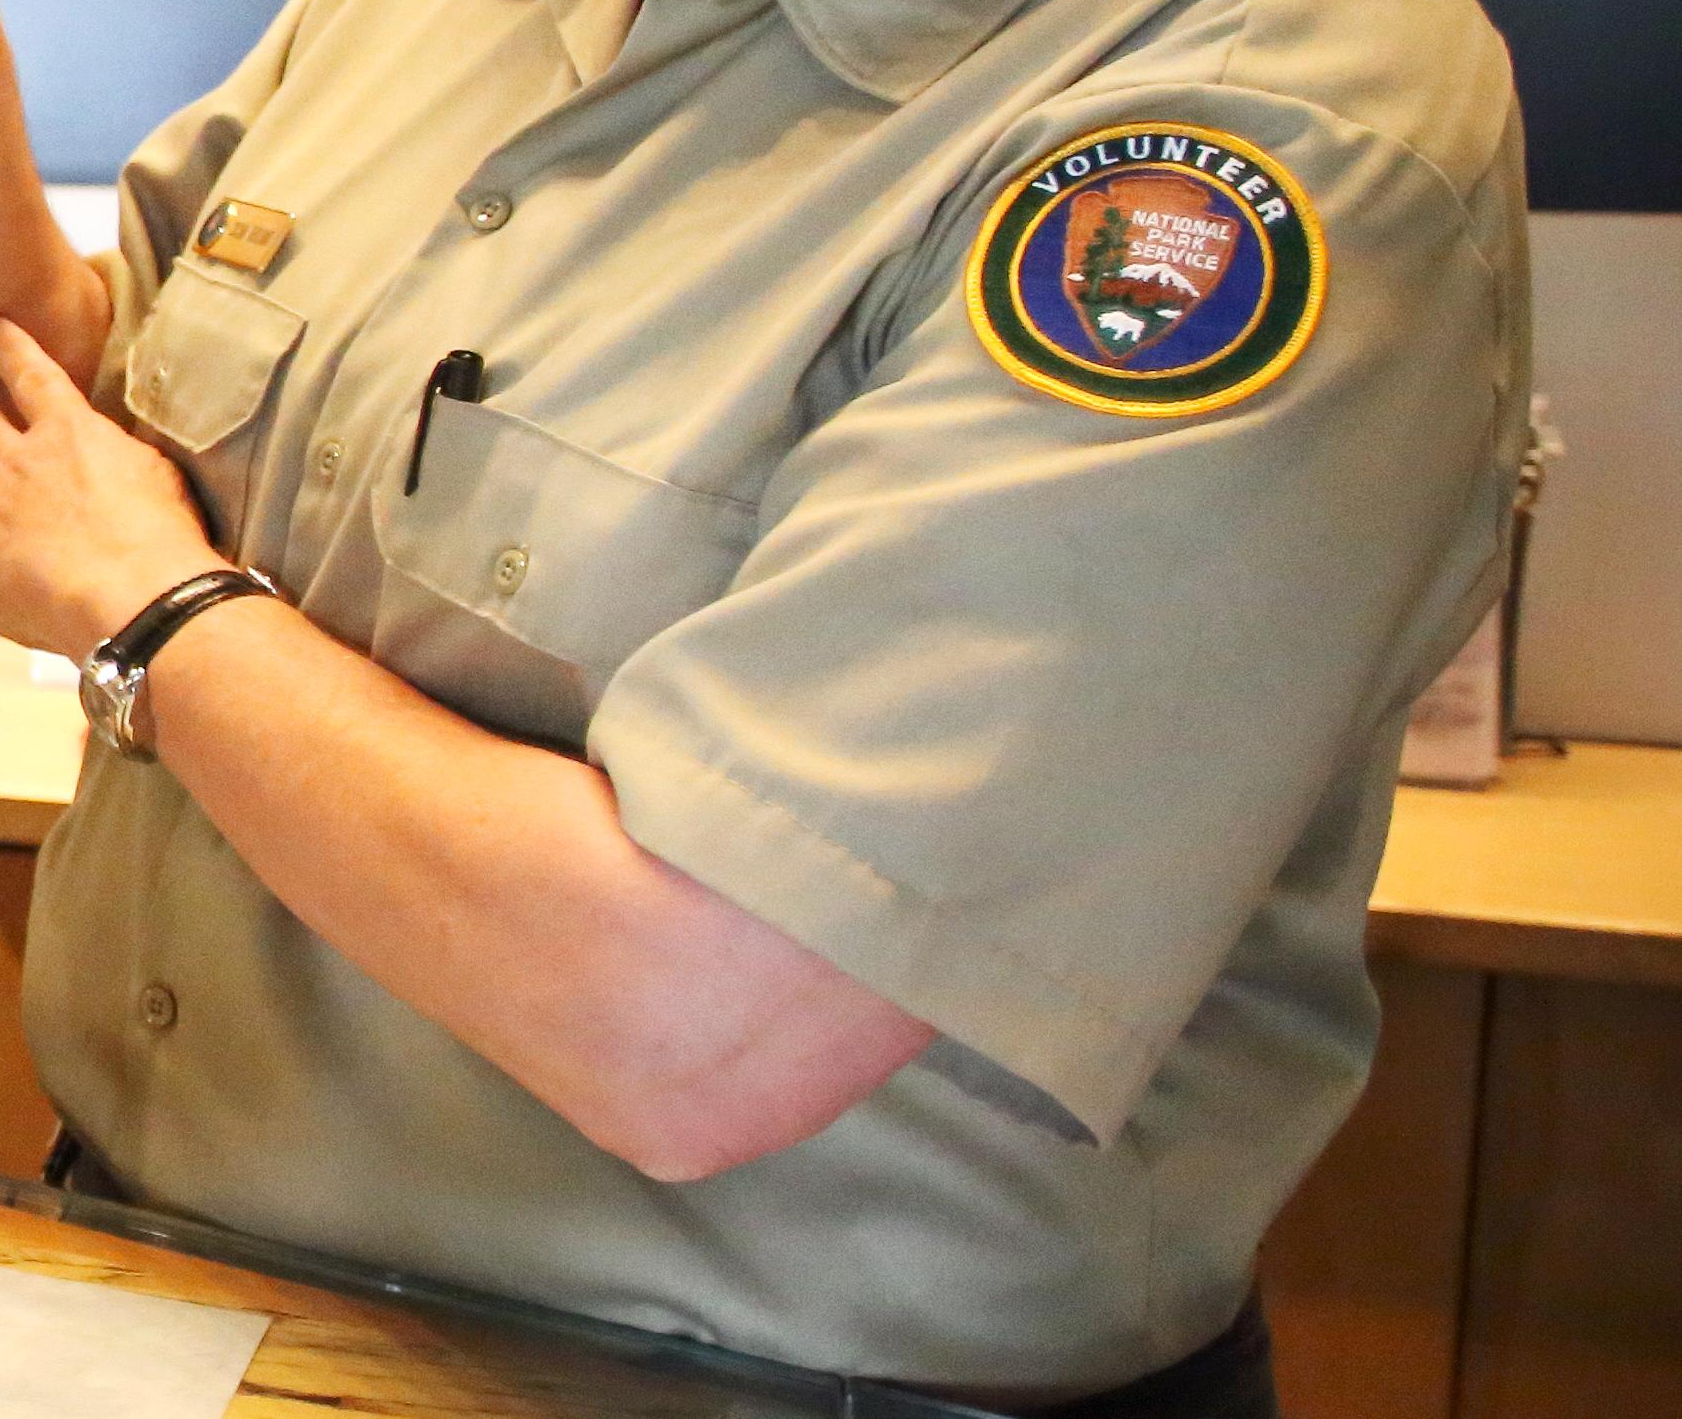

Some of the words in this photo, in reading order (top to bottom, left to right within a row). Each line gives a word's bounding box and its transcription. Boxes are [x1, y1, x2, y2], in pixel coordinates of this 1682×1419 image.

[1032, 135, 1288, 225] VOLUNTEER
[1131, 210, 1232, 242] NATIONAL
[1146, 228, 1207, 251] PARK
[1129, 240, 1219, 271] SERVICE
